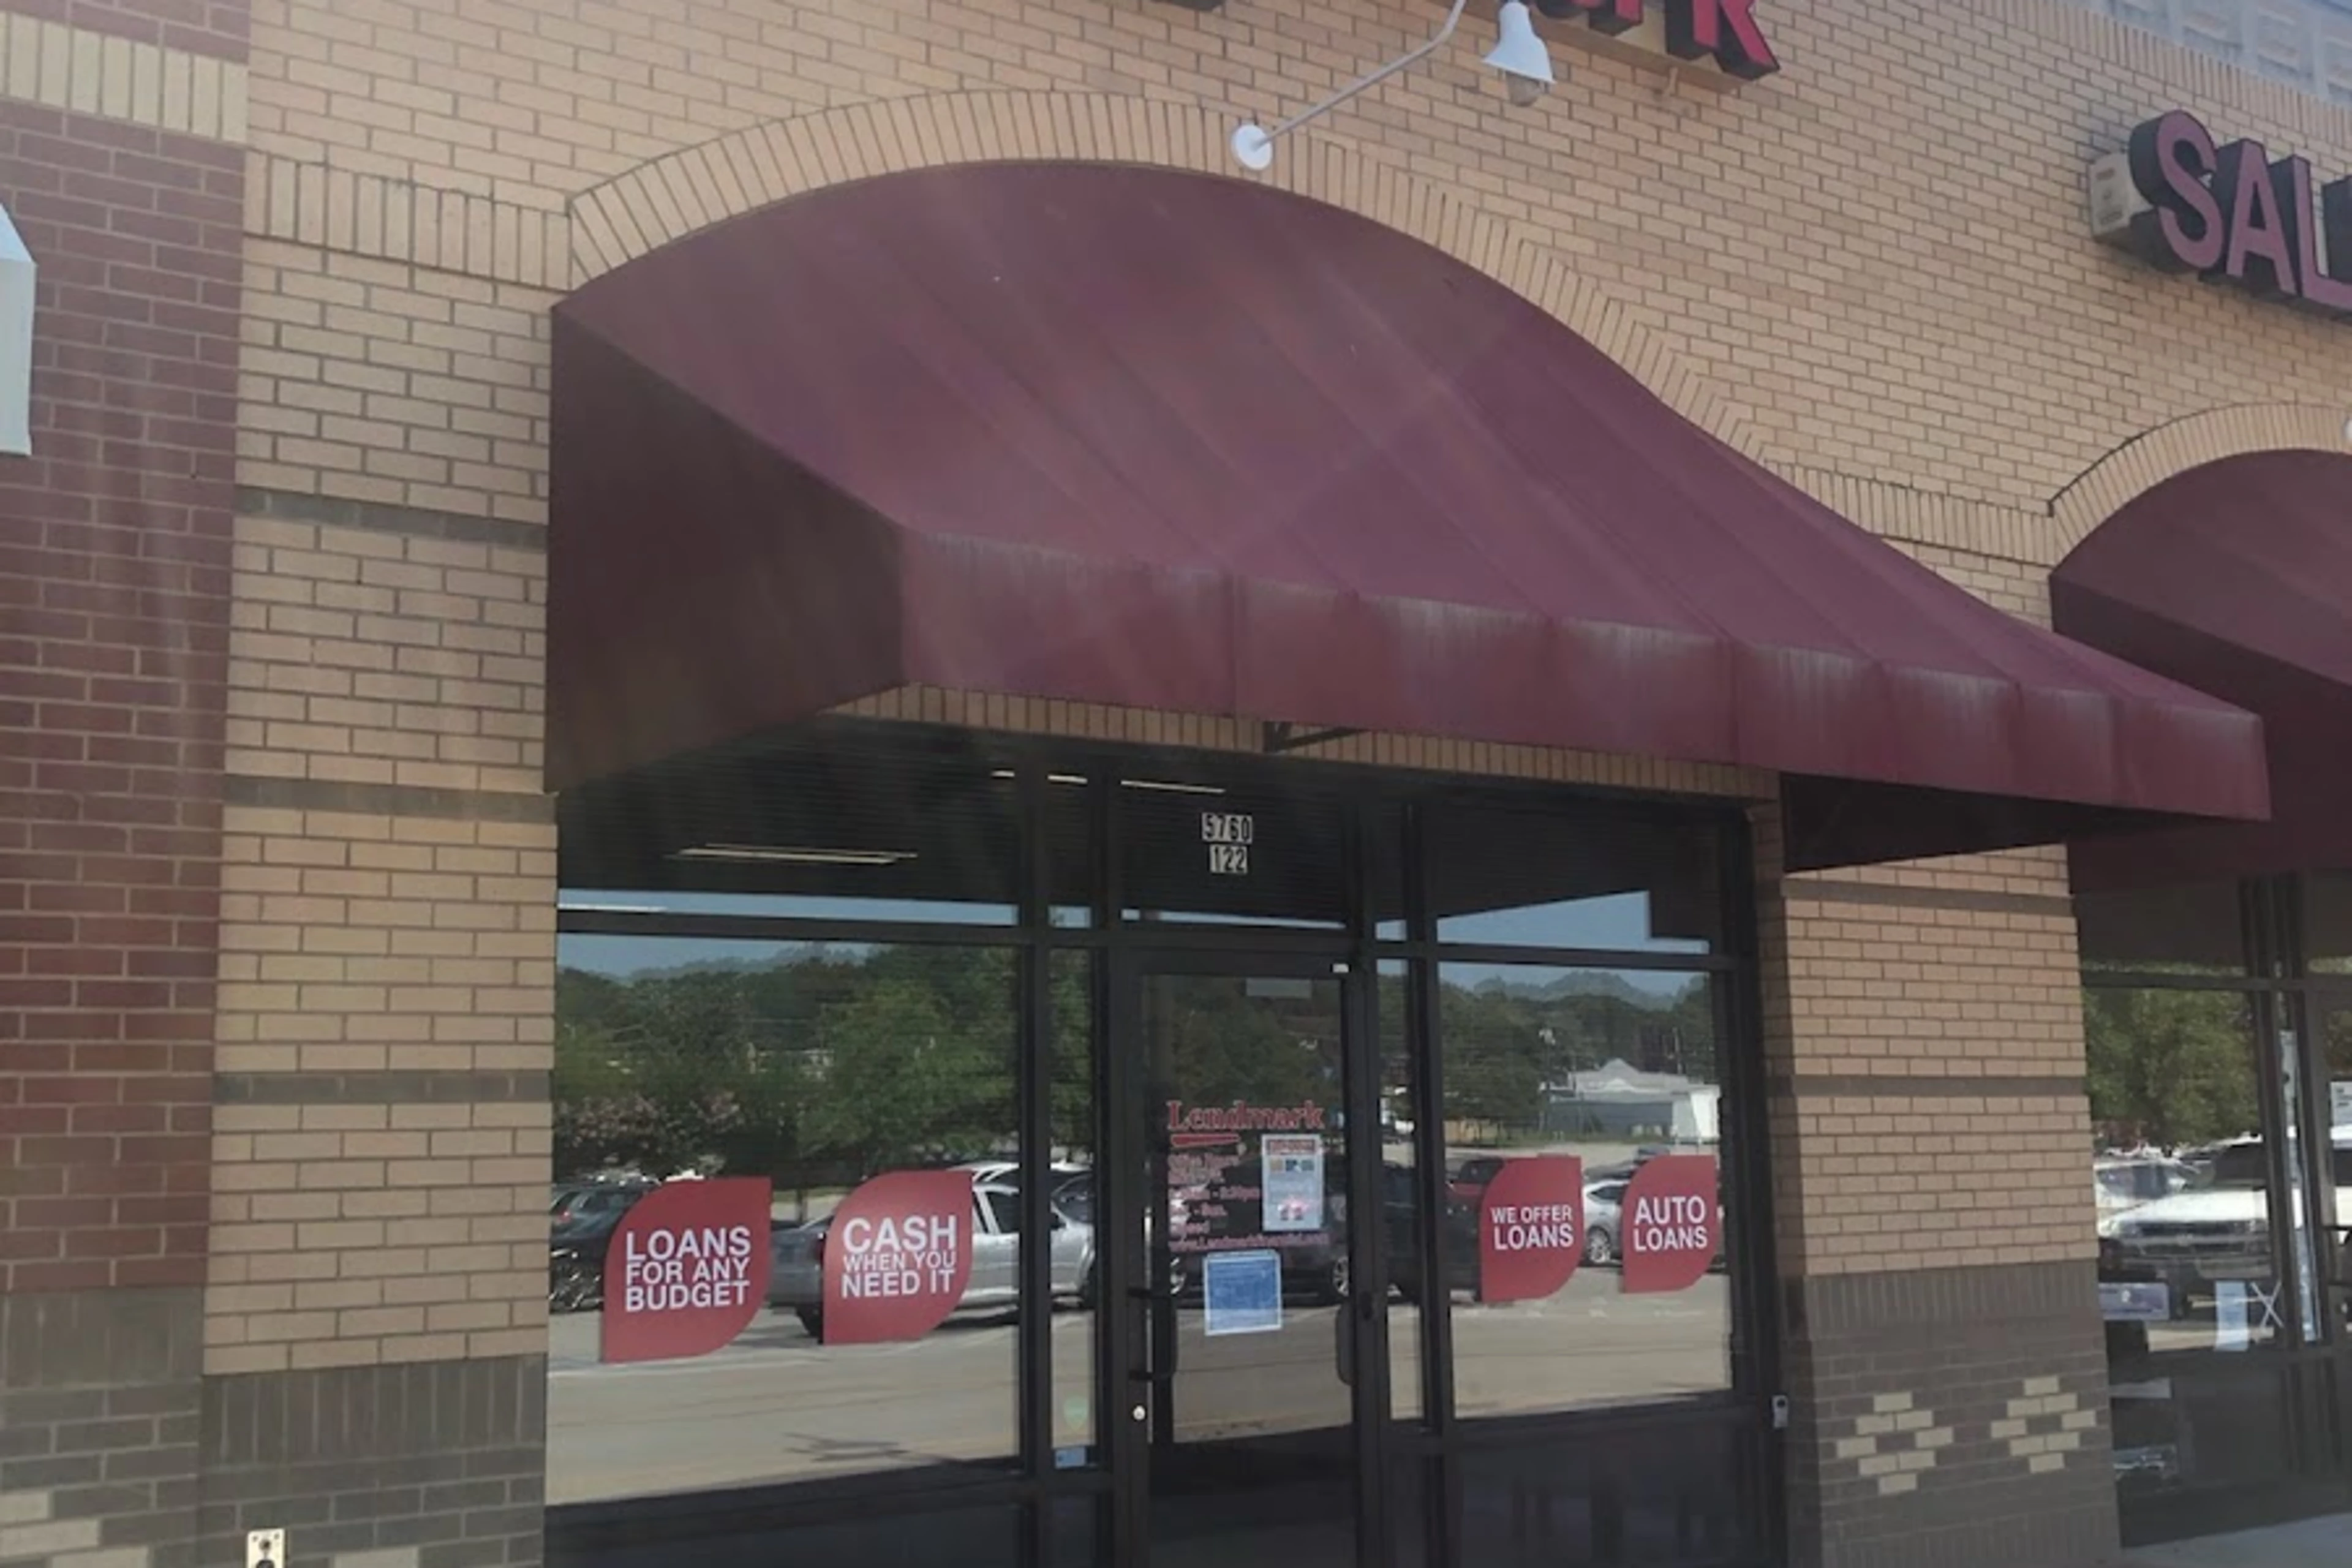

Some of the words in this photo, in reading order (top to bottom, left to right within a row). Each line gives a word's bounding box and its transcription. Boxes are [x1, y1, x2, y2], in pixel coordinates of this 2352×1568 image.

[2129, 108, 2352, 311] SAL
[1202, 812, 1252, 843] 5760
[1210, 845, 1248, 873] 122
[1167, 1101, 1324, 1129] Lendmark
[1490, 1207, 1516, 1224] WE
[1520, 1204, 1573, 1221] OFFER
[1634, 1196, 1706, 1224] AUTO
[626, 1226, 751, 1262] LOANS
[843, 1216, 956, 1253] CASH
[1494, 1223, 1574, 1250] LOANS
[1634, 1226, 1708, 1251] LOANS
[626, 1261, 683, 1284] FOR
[692, 1257, 749, 1283] ANY
[843, 1253, 907, 1272] WHEN
[914, 1250, 955, 1268] YOU
[626, 1281, 750, 1312] BUDGET
[842, 1272, 919, 1297] NEED
[930, 1269, 956, 1292] IT
